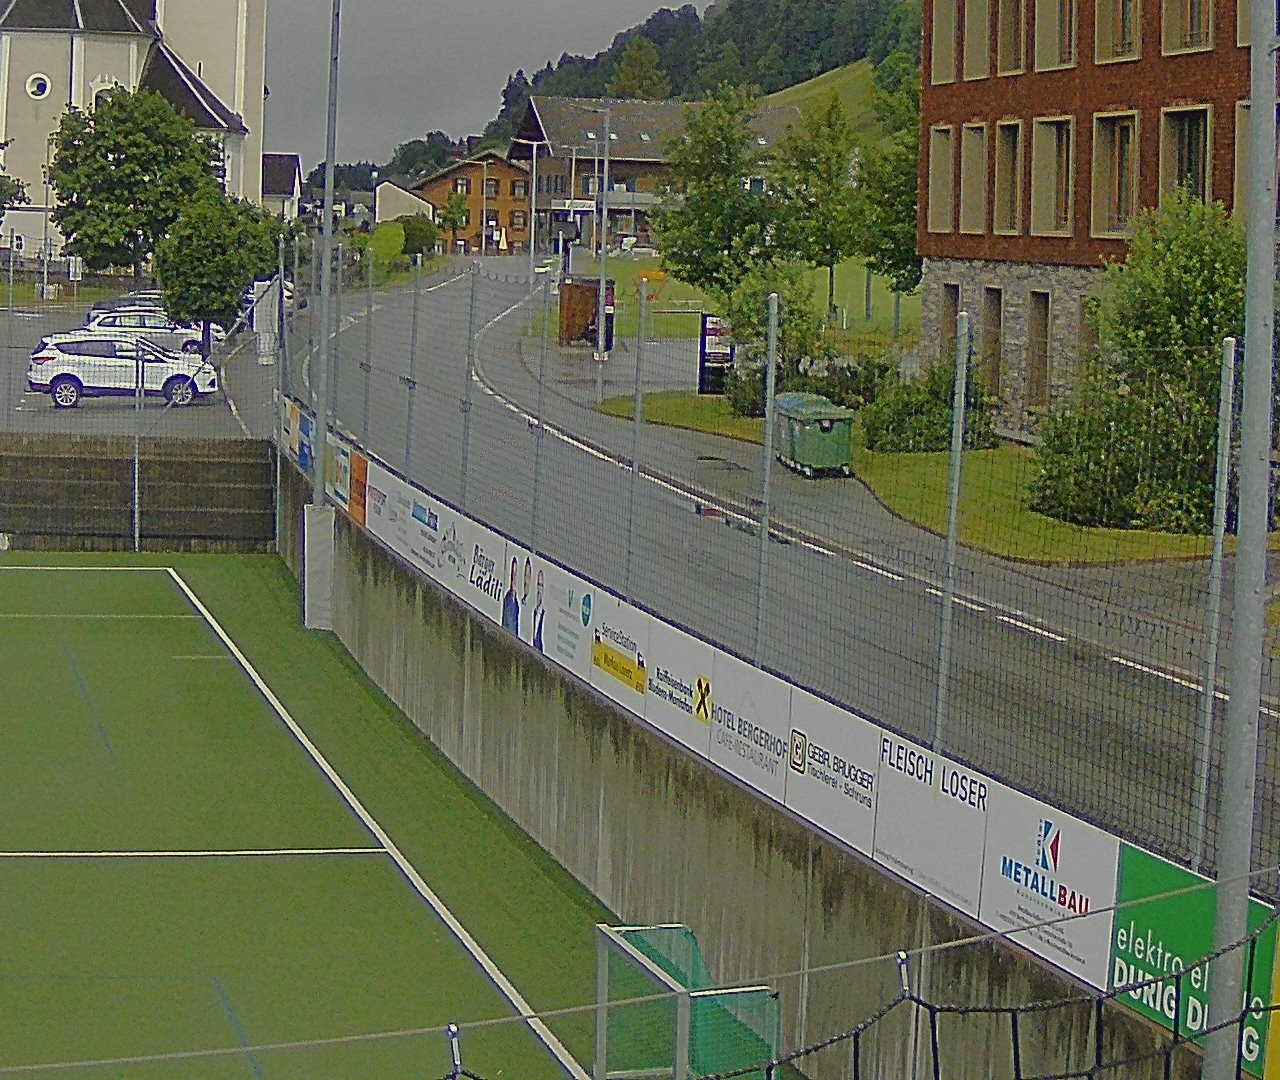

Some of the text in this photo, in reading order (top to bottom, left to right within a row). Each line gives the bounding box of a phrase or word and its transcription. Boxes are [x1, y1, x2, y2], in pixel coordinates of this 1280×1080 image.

[711, 703, 789, 759] HOTEL BERGERHOF
[881, 737, 987, 812] FLEISCH LOSER
[1001, 855, 1090, 916] METALLBAU
